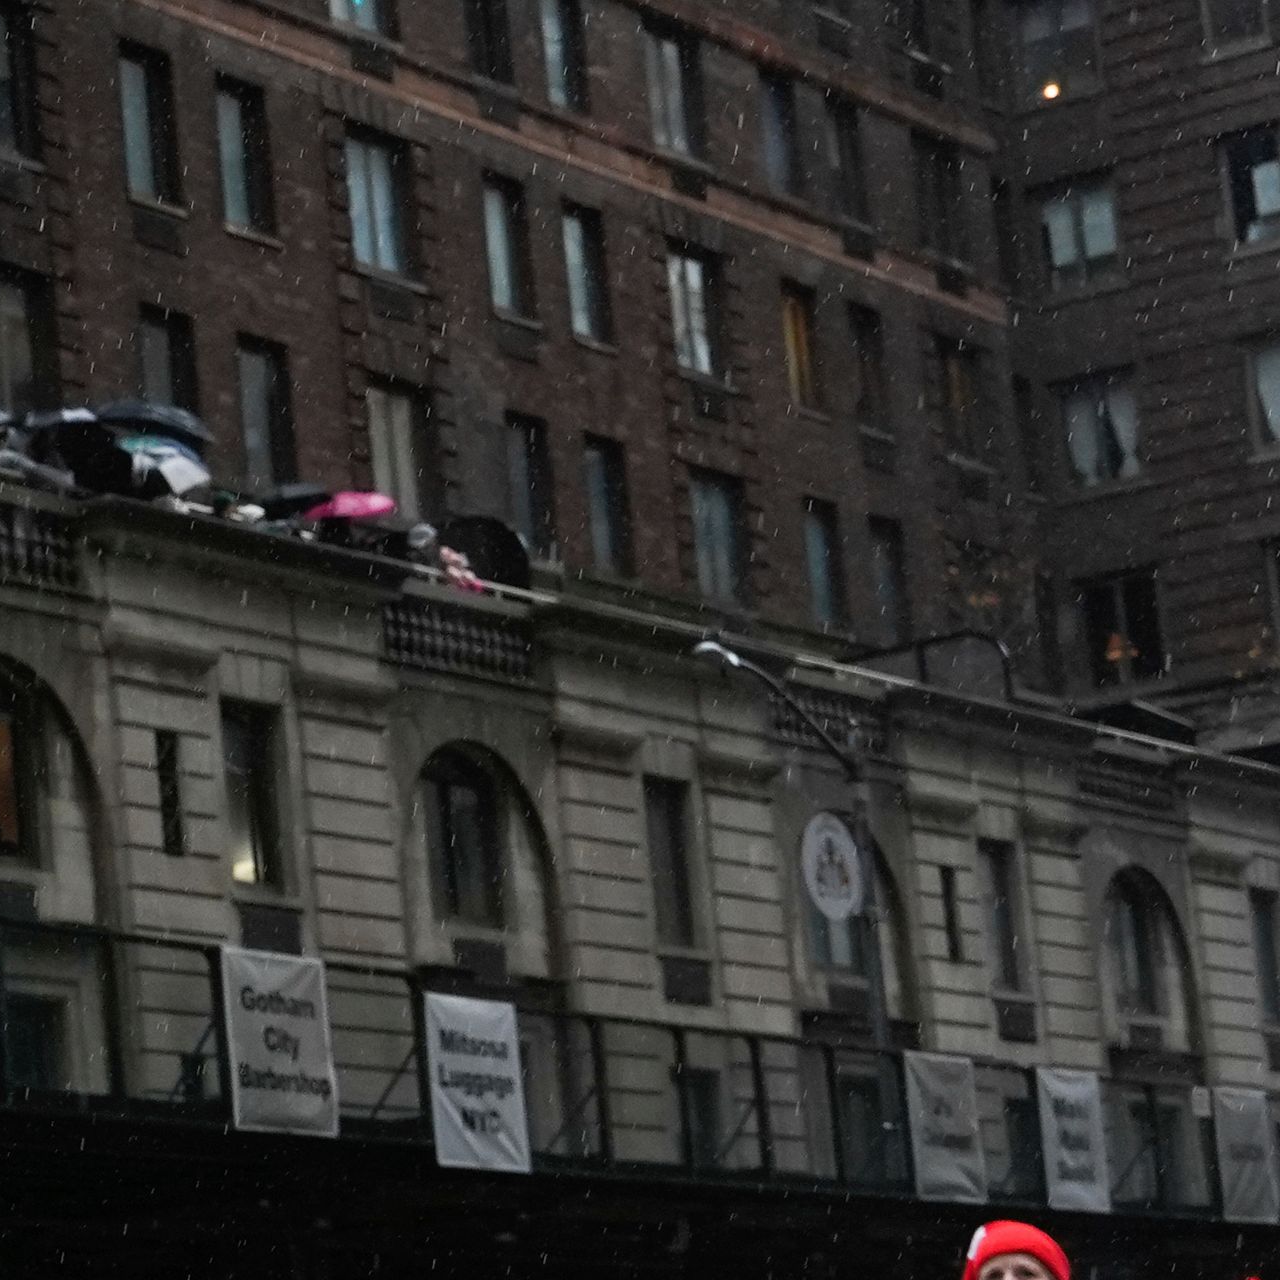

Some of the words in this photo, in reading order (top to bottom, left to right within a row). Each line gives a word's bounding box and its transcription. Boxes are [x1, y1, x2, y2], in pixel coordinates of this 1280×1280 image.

[240, 985, 315, 1019] Gotham
[263, 1026, 300, 1060] City
[238, 1061, 331, 1101] Barbershop
